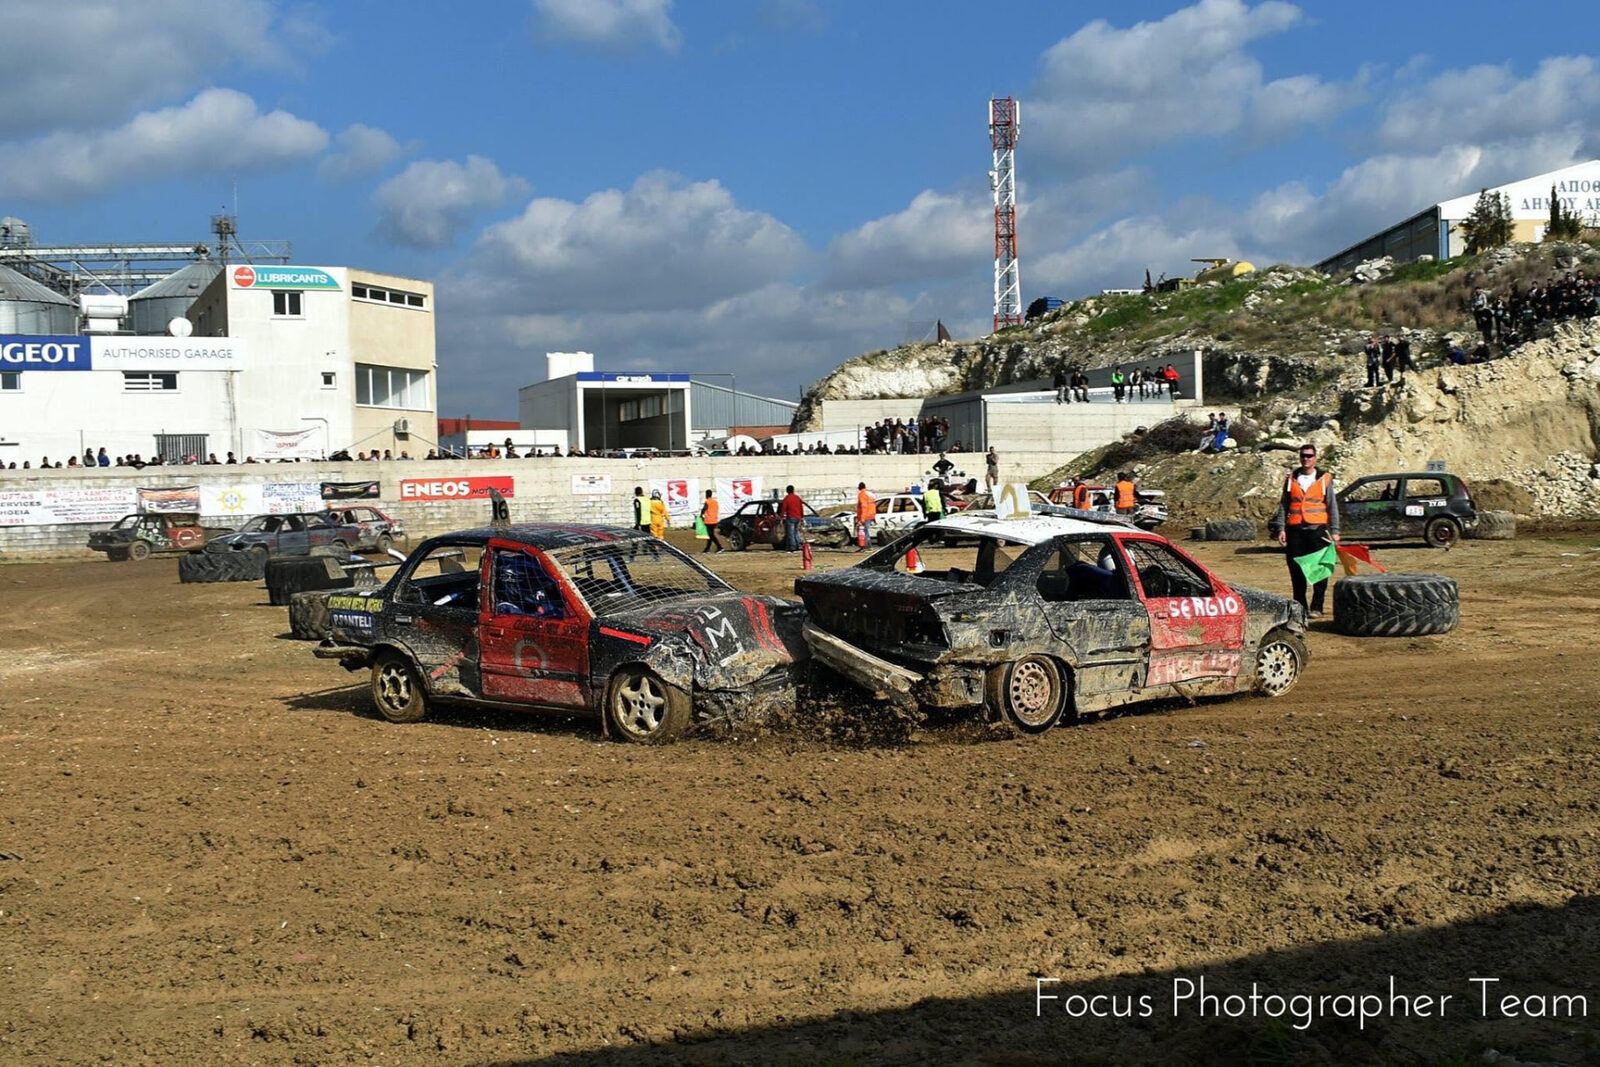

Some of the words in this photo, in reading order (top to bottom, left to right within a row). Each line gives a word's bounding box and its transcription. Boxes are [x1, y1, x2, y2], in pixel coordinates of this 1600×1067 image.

[257, 273, 329, 284] LUBRICANTS
[0, 342, 81, 363] GEOT
[103, 347, 181, 359] AUTHORISED
[184, 348, 233, 359] GARAGE
[402, 481, 471, 497] ENEOS
[492, 500, 508, 520] 16
[1169, 596, 1239, 619] SERGIO
